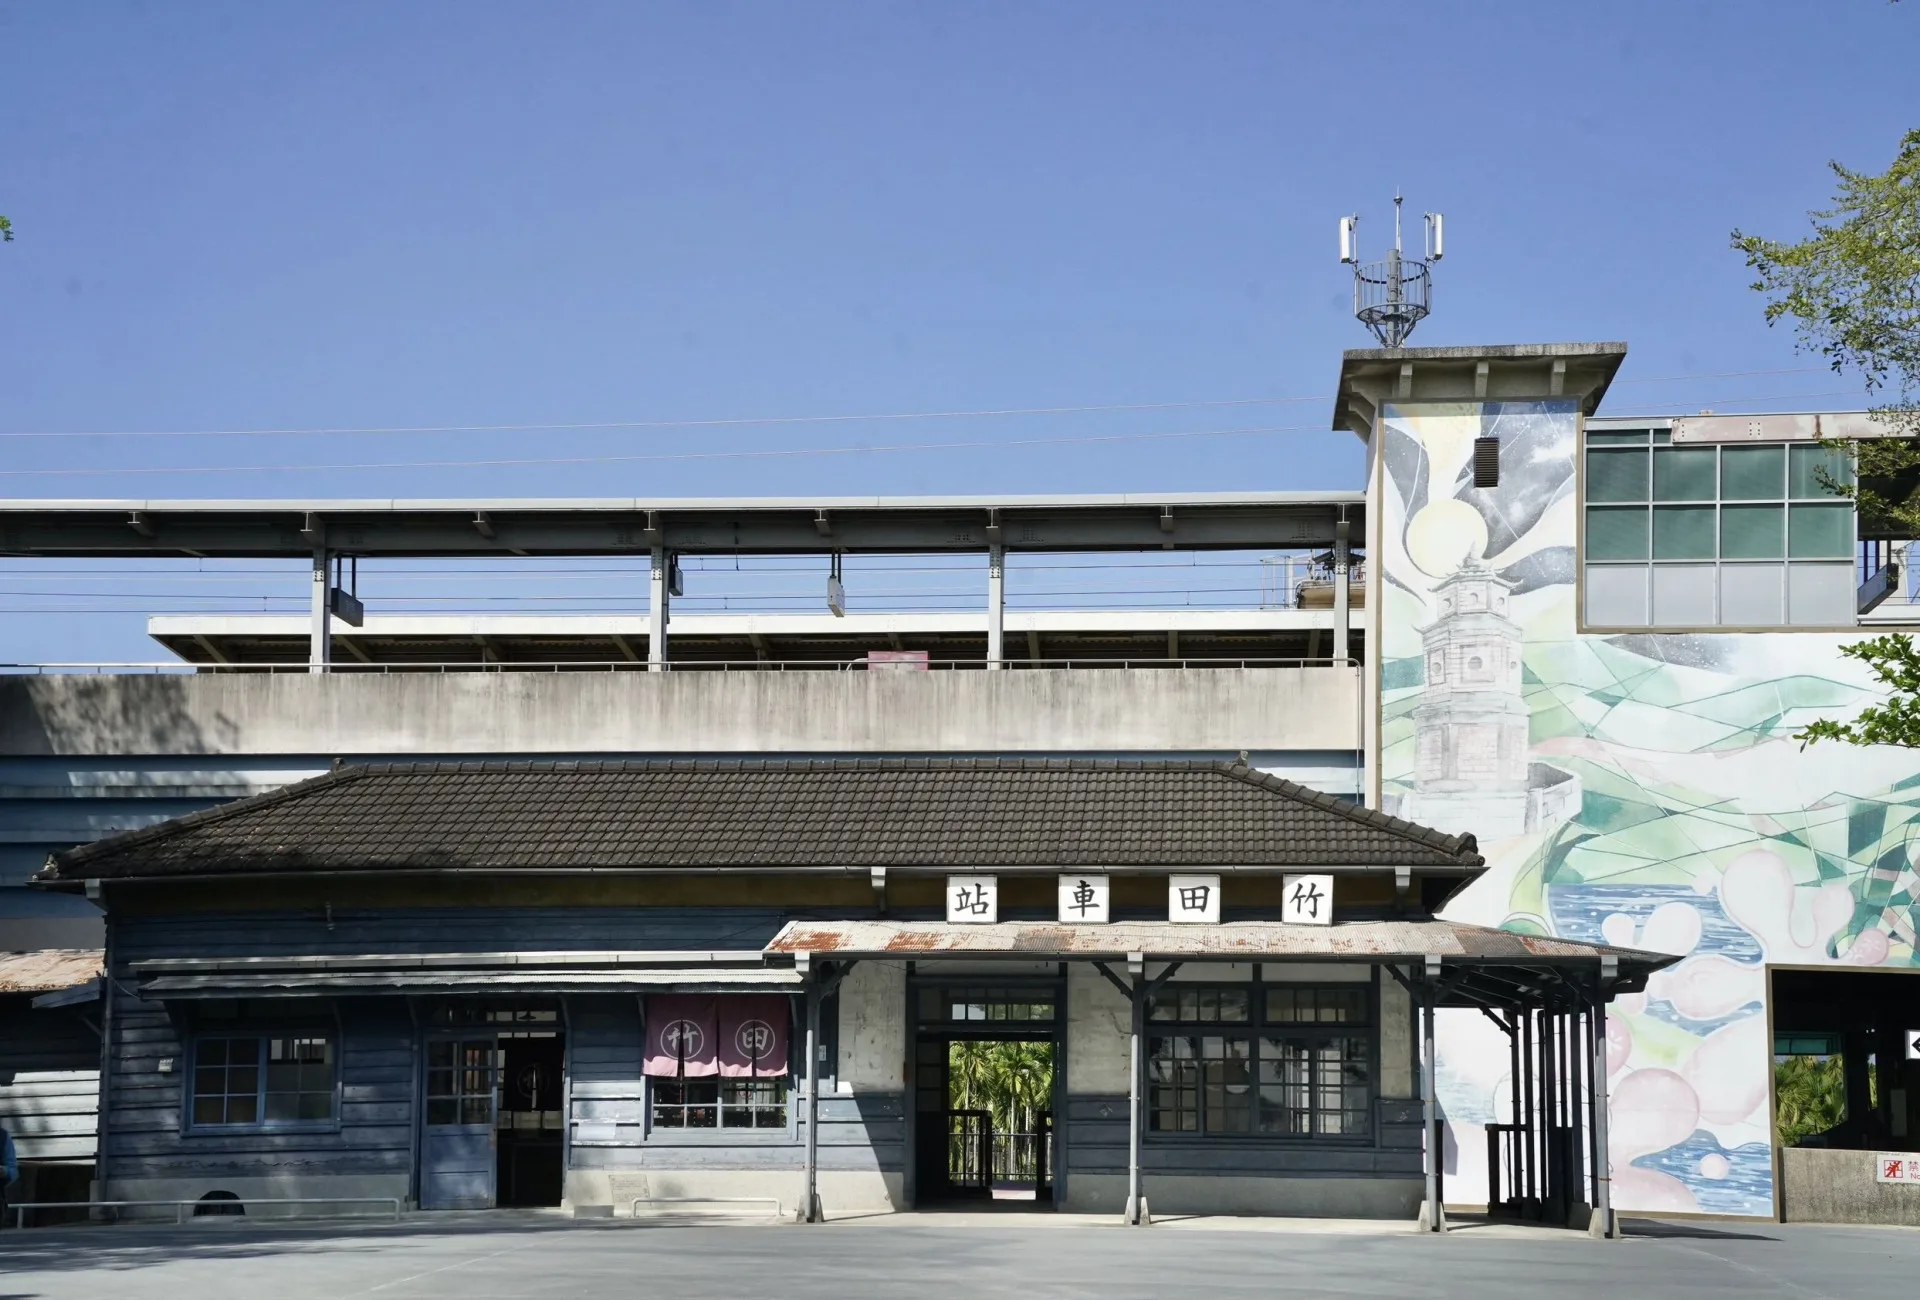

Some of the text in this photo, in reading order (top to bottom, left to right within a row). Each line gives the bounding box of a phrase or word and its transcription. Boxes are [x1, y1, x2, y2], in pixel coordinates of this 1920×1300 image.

[954, 879, 1325, 919] 竹 田 車 站
[667, 1023, 768, 1054] 竹 田
